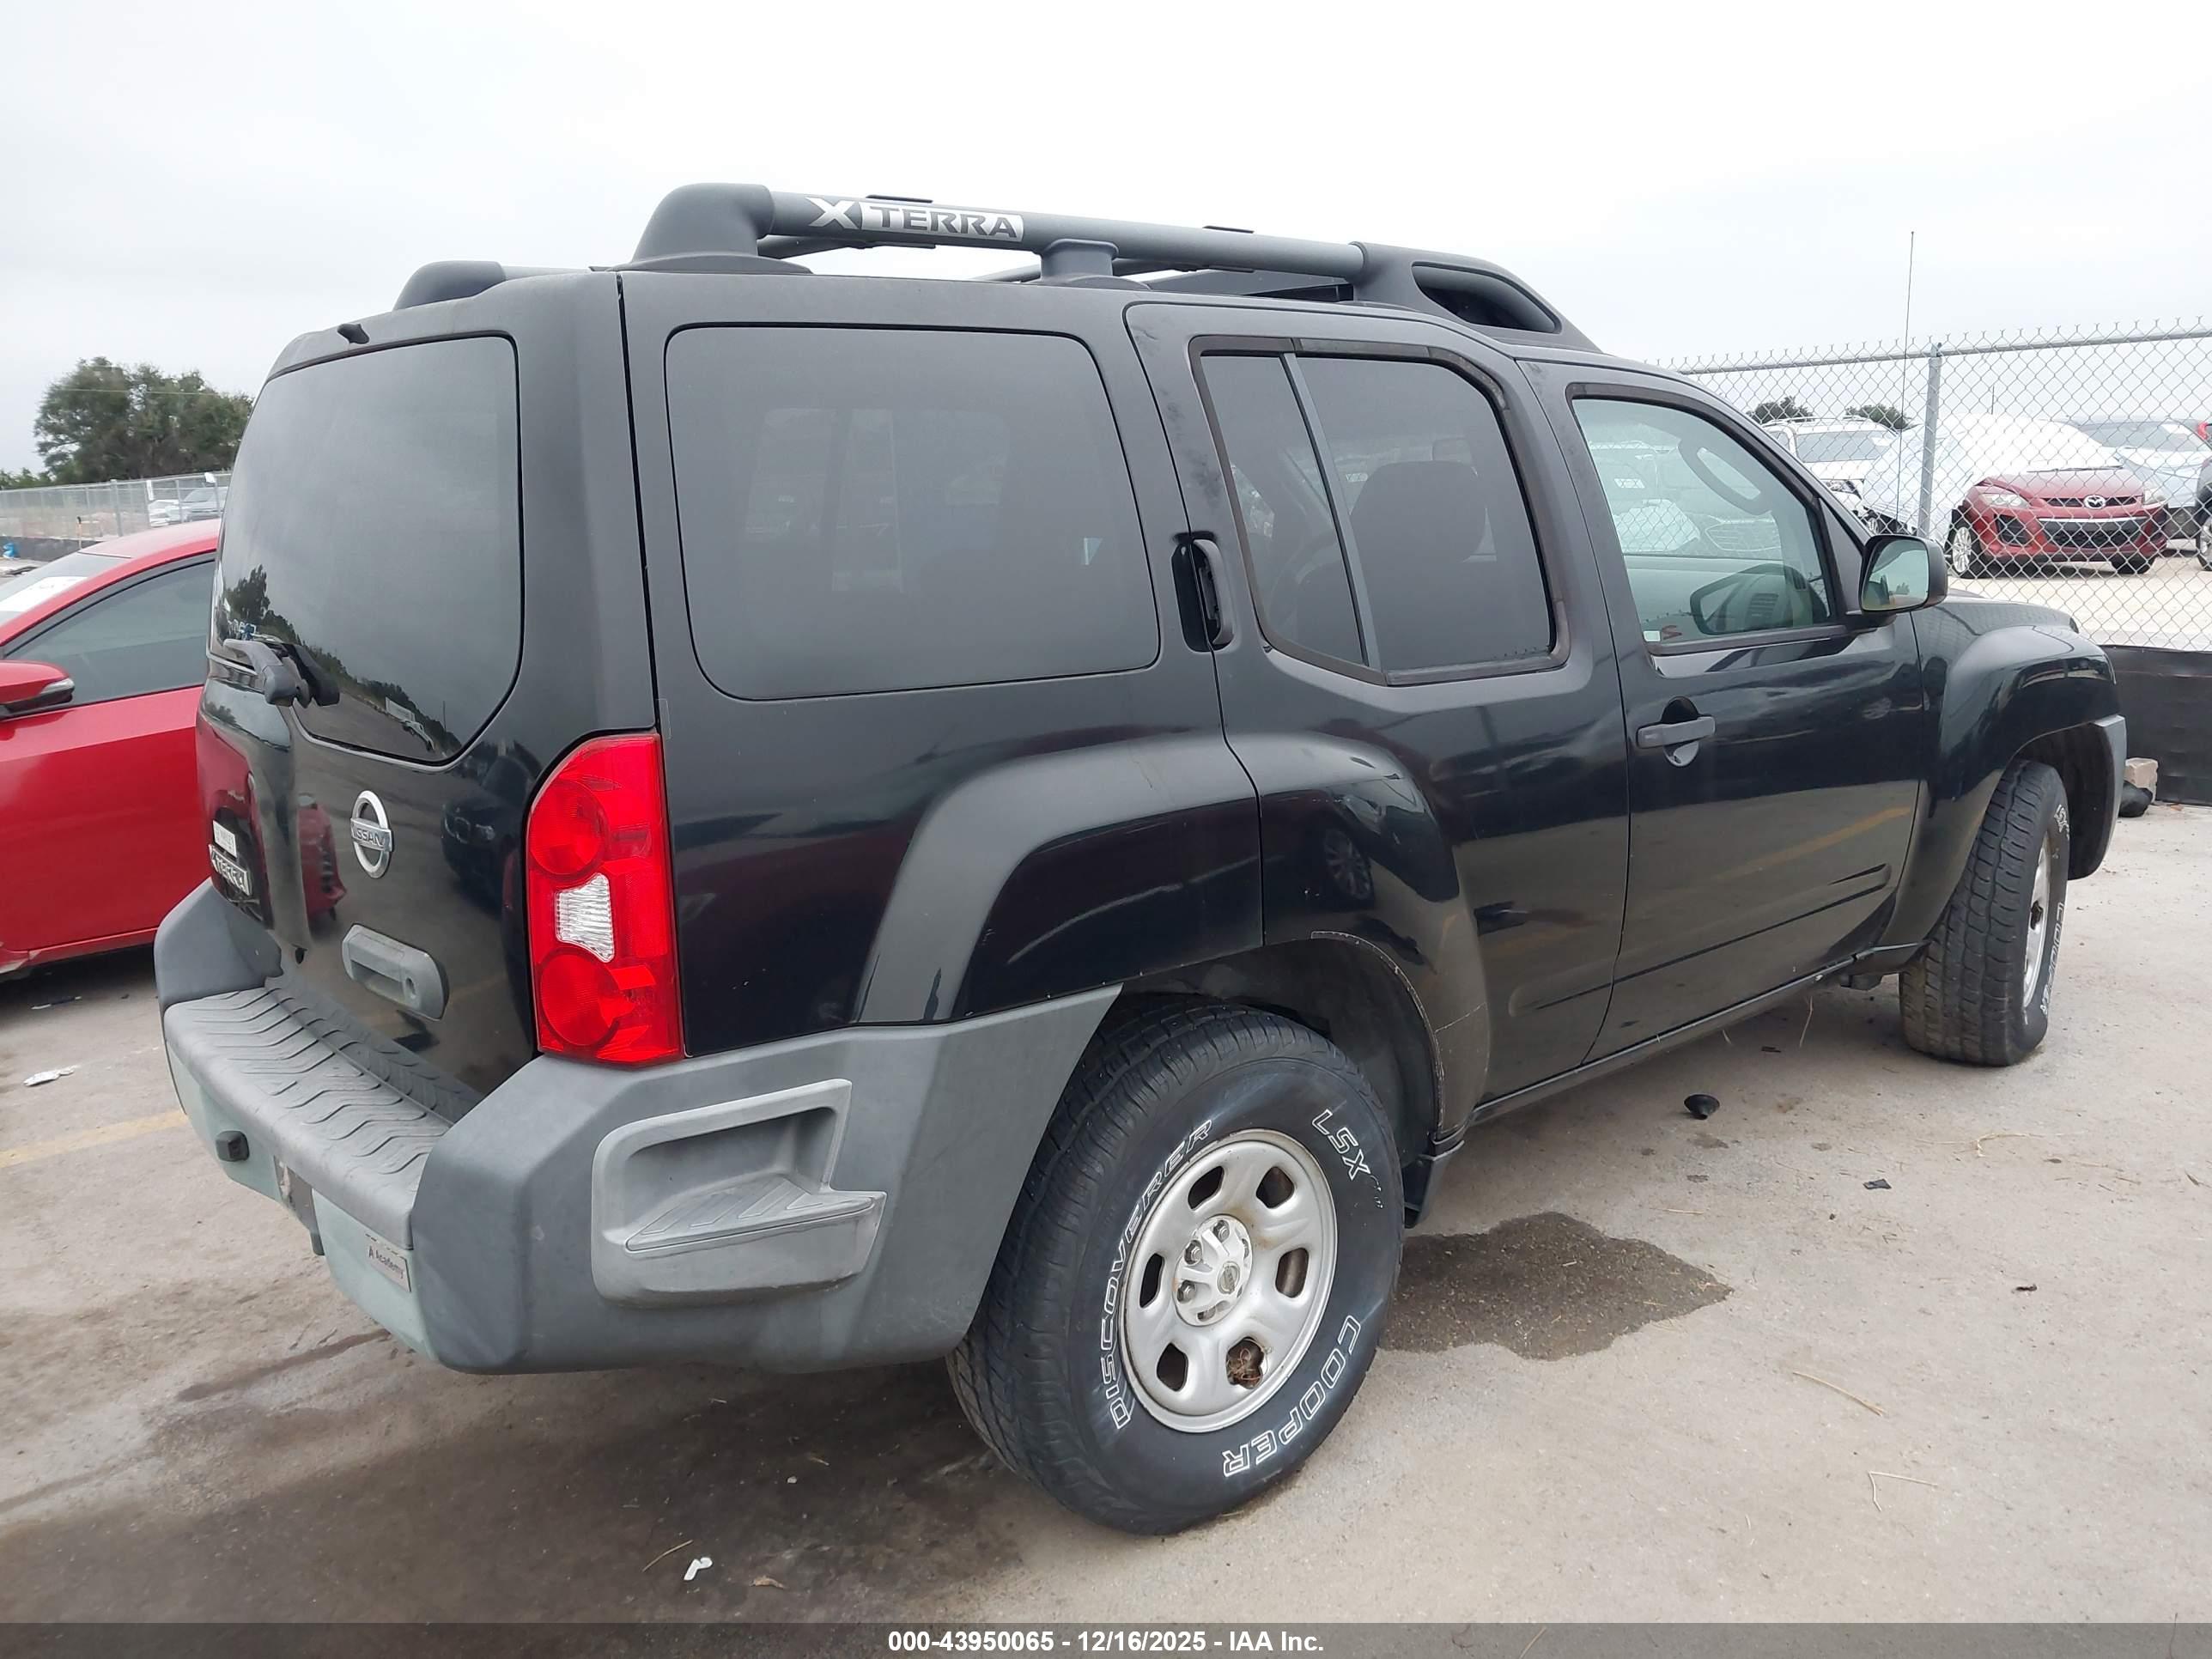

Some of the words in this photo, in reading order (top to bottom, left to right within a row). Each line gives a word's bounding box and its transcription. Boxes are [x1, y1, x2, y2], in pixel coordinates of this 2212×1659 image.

[1310, 1109, 1371, 1182] LSX
[1100, 1119, 1213, 1430] DISCOVERER
[1222, 1315, 1362, 1477] COOPER
